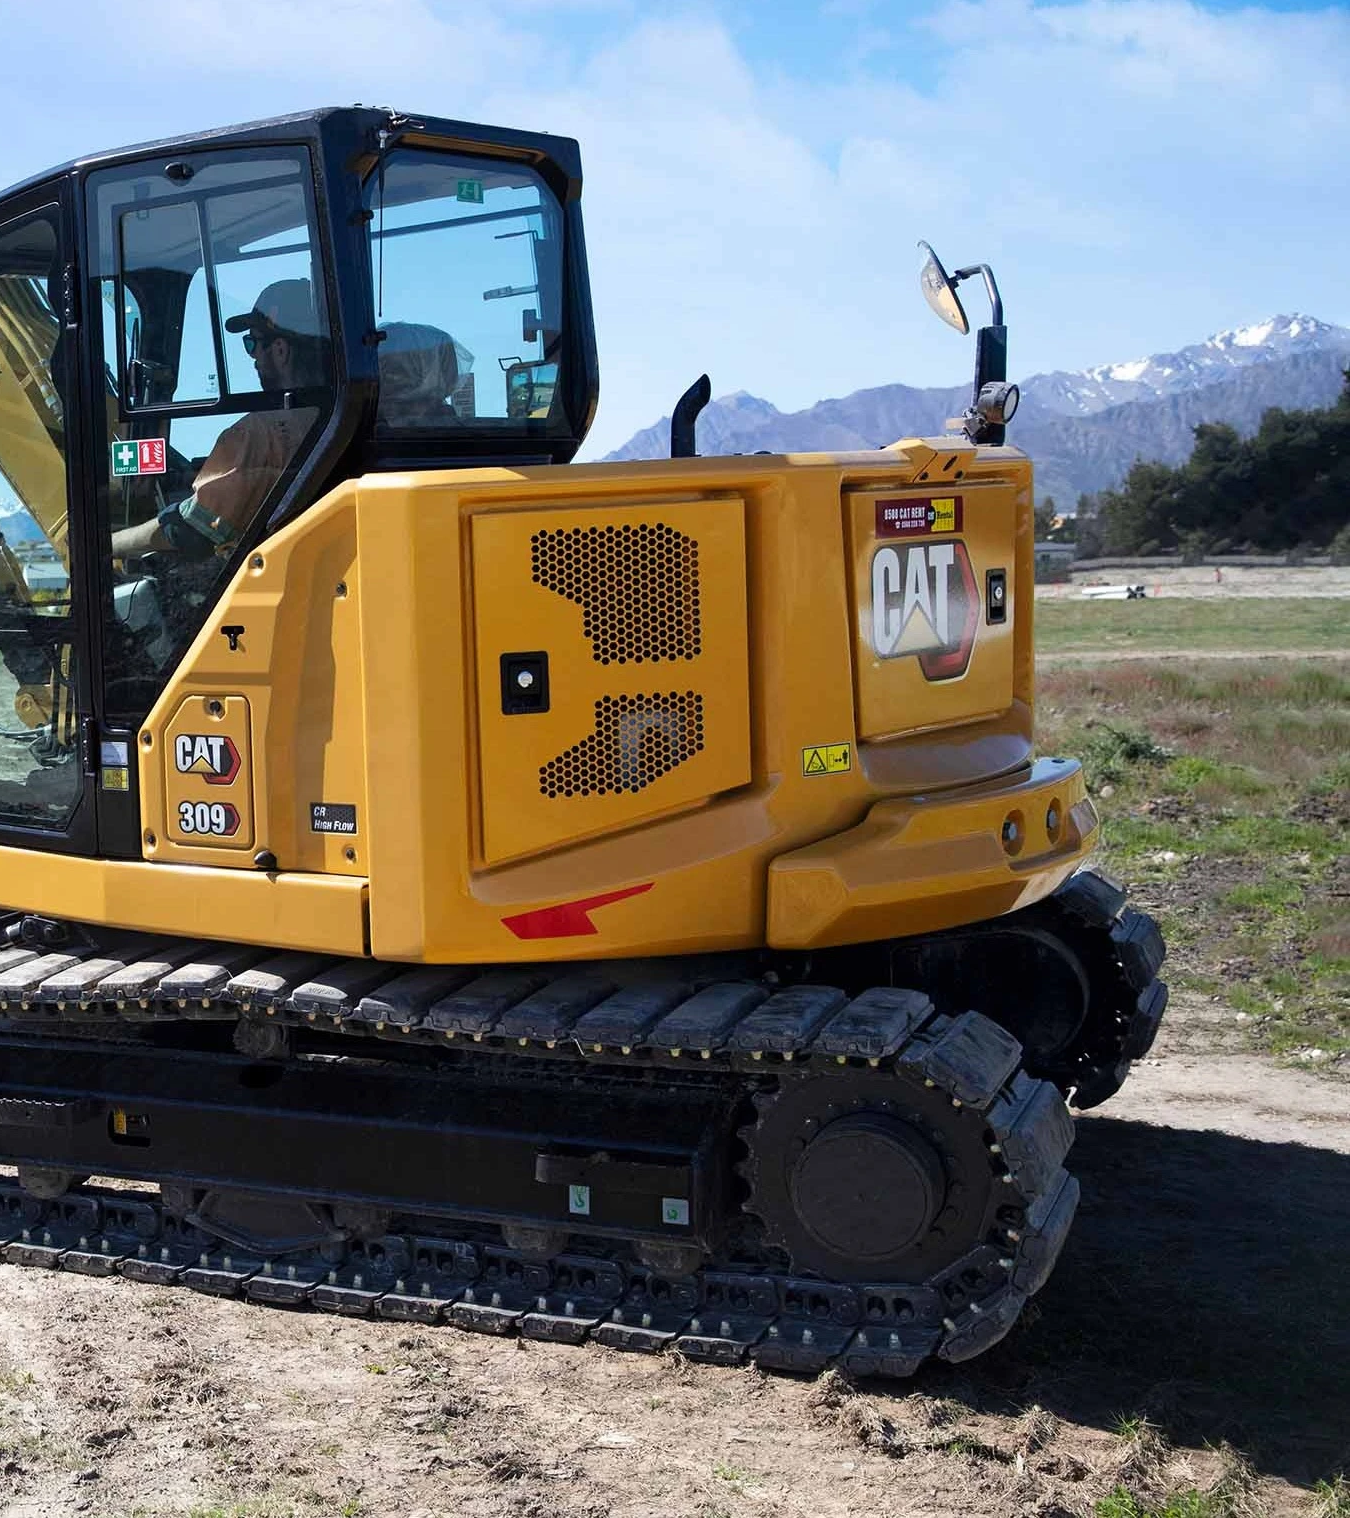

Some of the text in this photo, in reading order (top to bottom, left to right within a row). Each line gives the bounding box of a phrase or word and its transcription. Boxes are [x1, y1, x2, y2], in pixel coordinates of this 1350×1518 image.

[899, 507, 911, 519] CAT
[911, 507, 925, 518] RENT
[873, 545, 954, 656] CAT
[176, 735, 225, 773] CAT
[179, 802, 226, 834] 309
[313, 806, 327, 817] CR
[314, 818, 355, 831] HIGH FLOW
